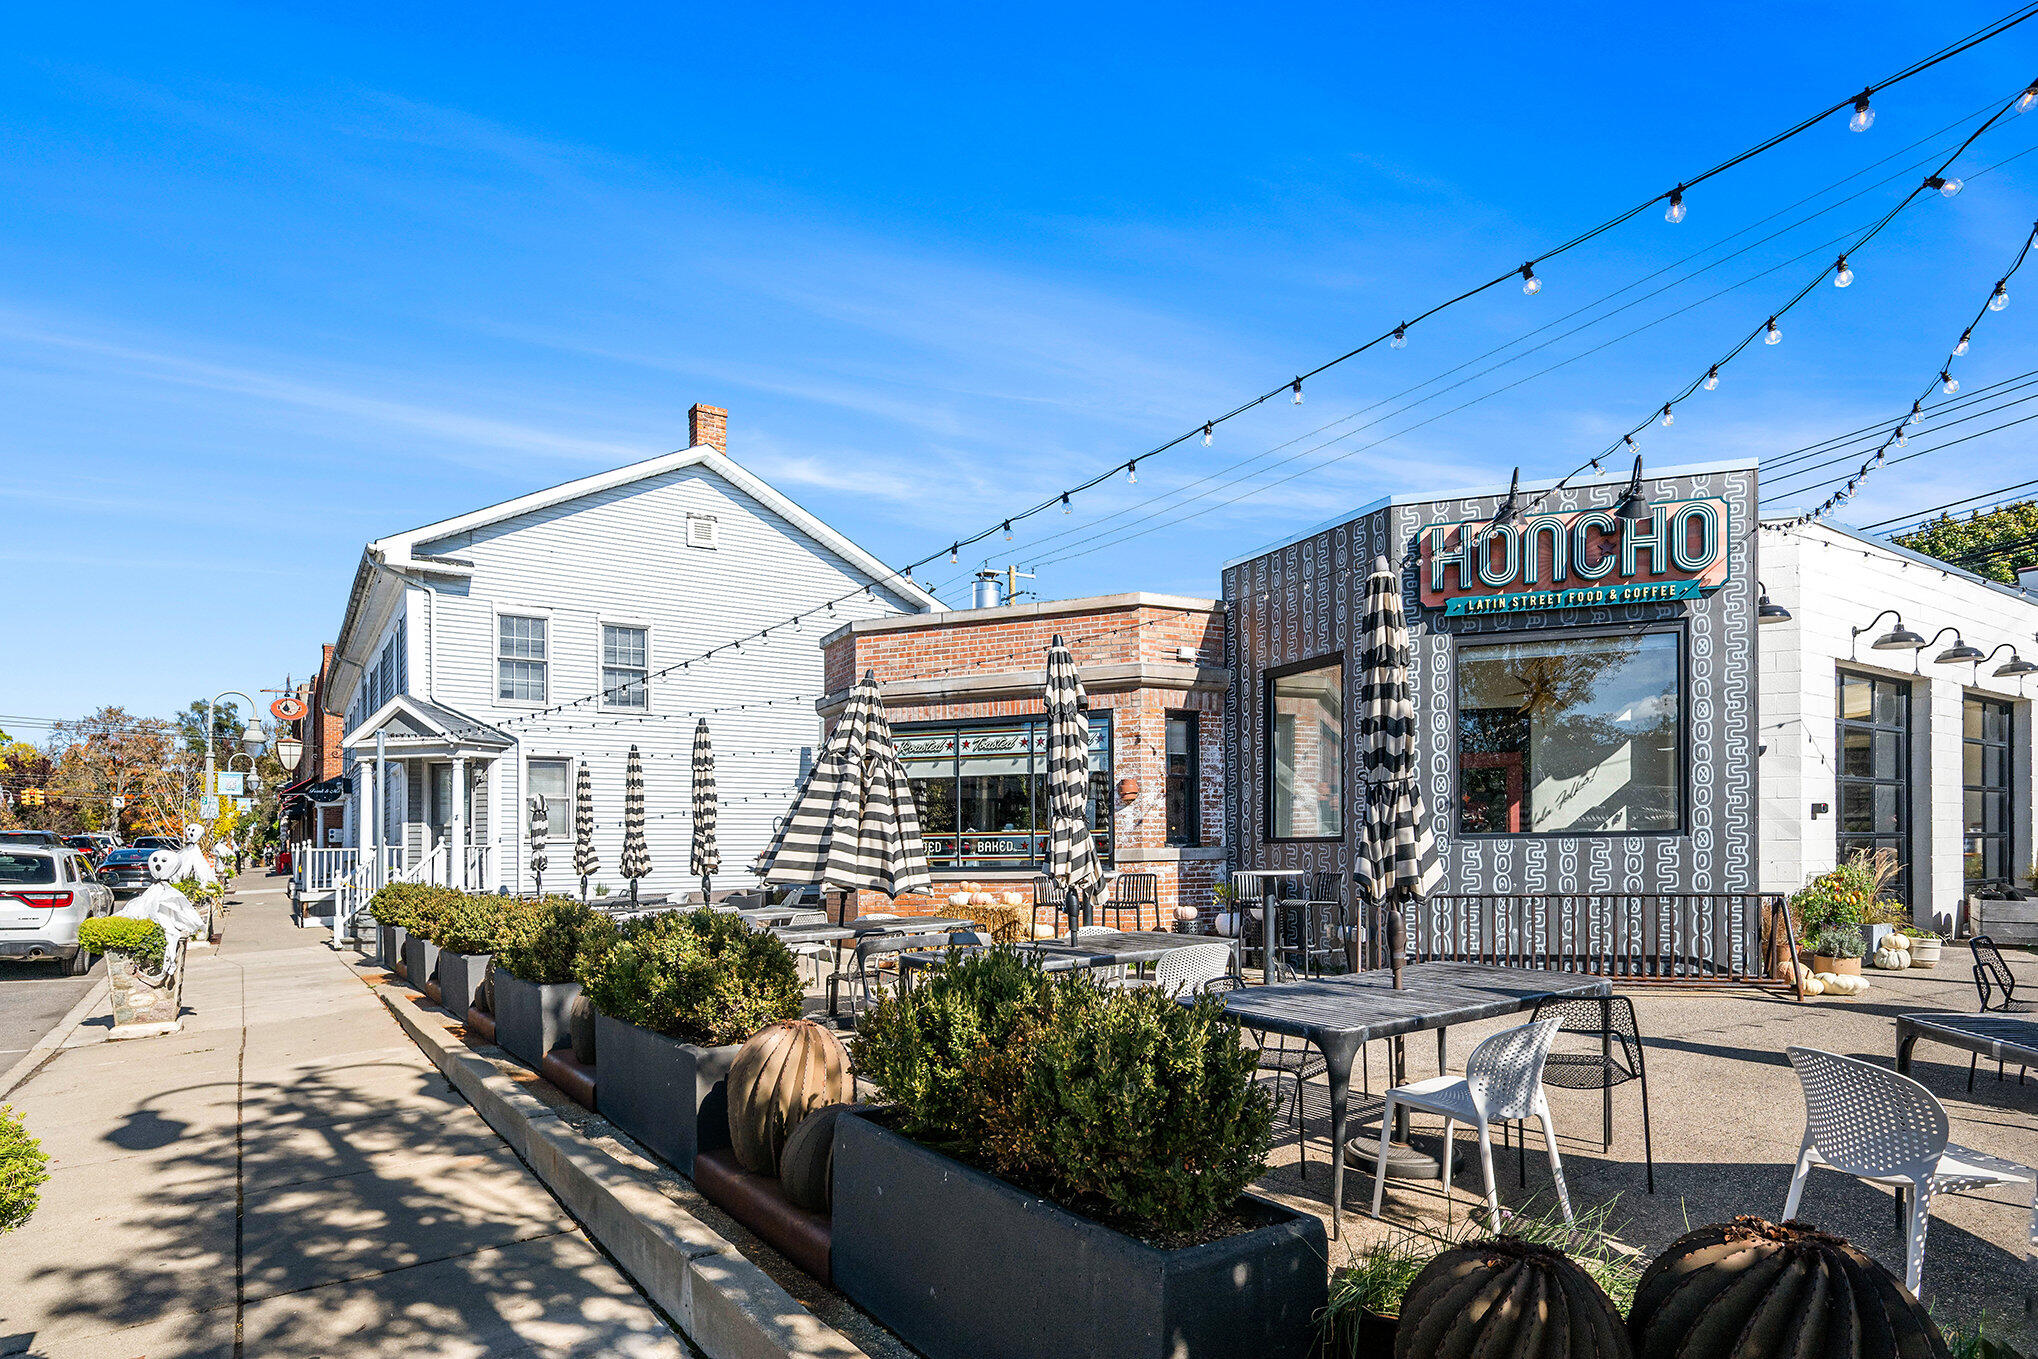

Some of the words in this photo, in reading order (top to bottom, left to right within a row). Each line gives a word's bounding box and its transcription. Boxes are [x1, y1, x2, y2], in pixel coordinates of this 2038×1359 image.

[1431, 501, 1719, 591] HONCHO
[1468, 597, 1506, 611] LATIN
[1512, 593, 1562, 608] STREET
[1569, 590, 1603, 603] FOOD
[1609, 589, 1618, 600] &
[1624, 585, 1676, 599] COFFEE
[899, 739, 947, 756] Roasted
[972, 735, 1019, 752] Toasted
[977, 840, 1014, 852] BAKED
